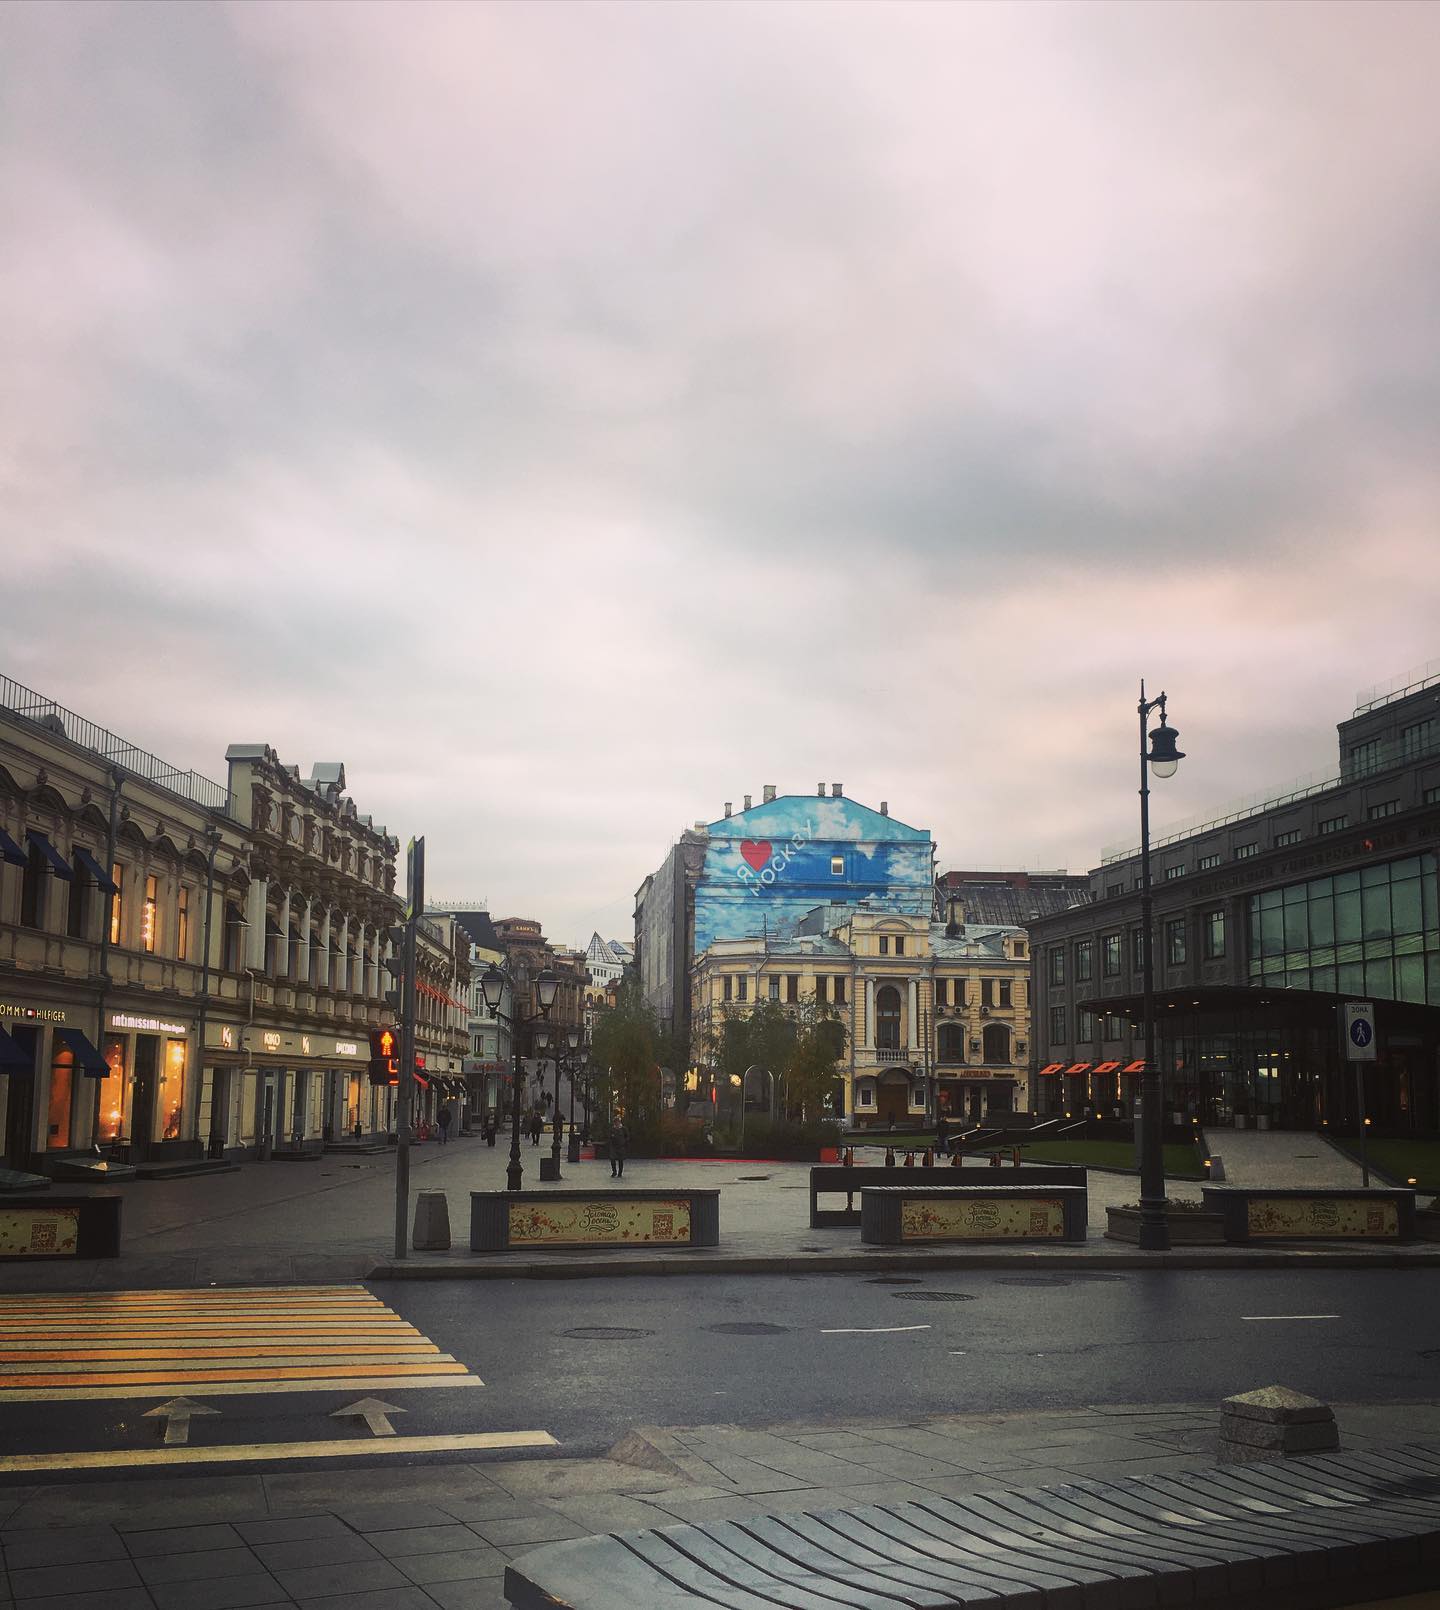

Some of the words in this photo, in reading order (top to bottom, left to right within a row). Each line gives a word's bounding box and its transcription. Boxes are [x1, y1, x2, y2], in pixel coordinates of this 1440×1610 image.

[749, 819, 812, 897] МОСКВУ
[737, 865, 754, 885] Я
[0, 1004, 26, 1017] OMMY
[36, 1009, 66, 1022] HILFIGER
[1351, 1006, 1369, 1014] ЗОНА
[264, 1032, 281, 1046] KIKO
